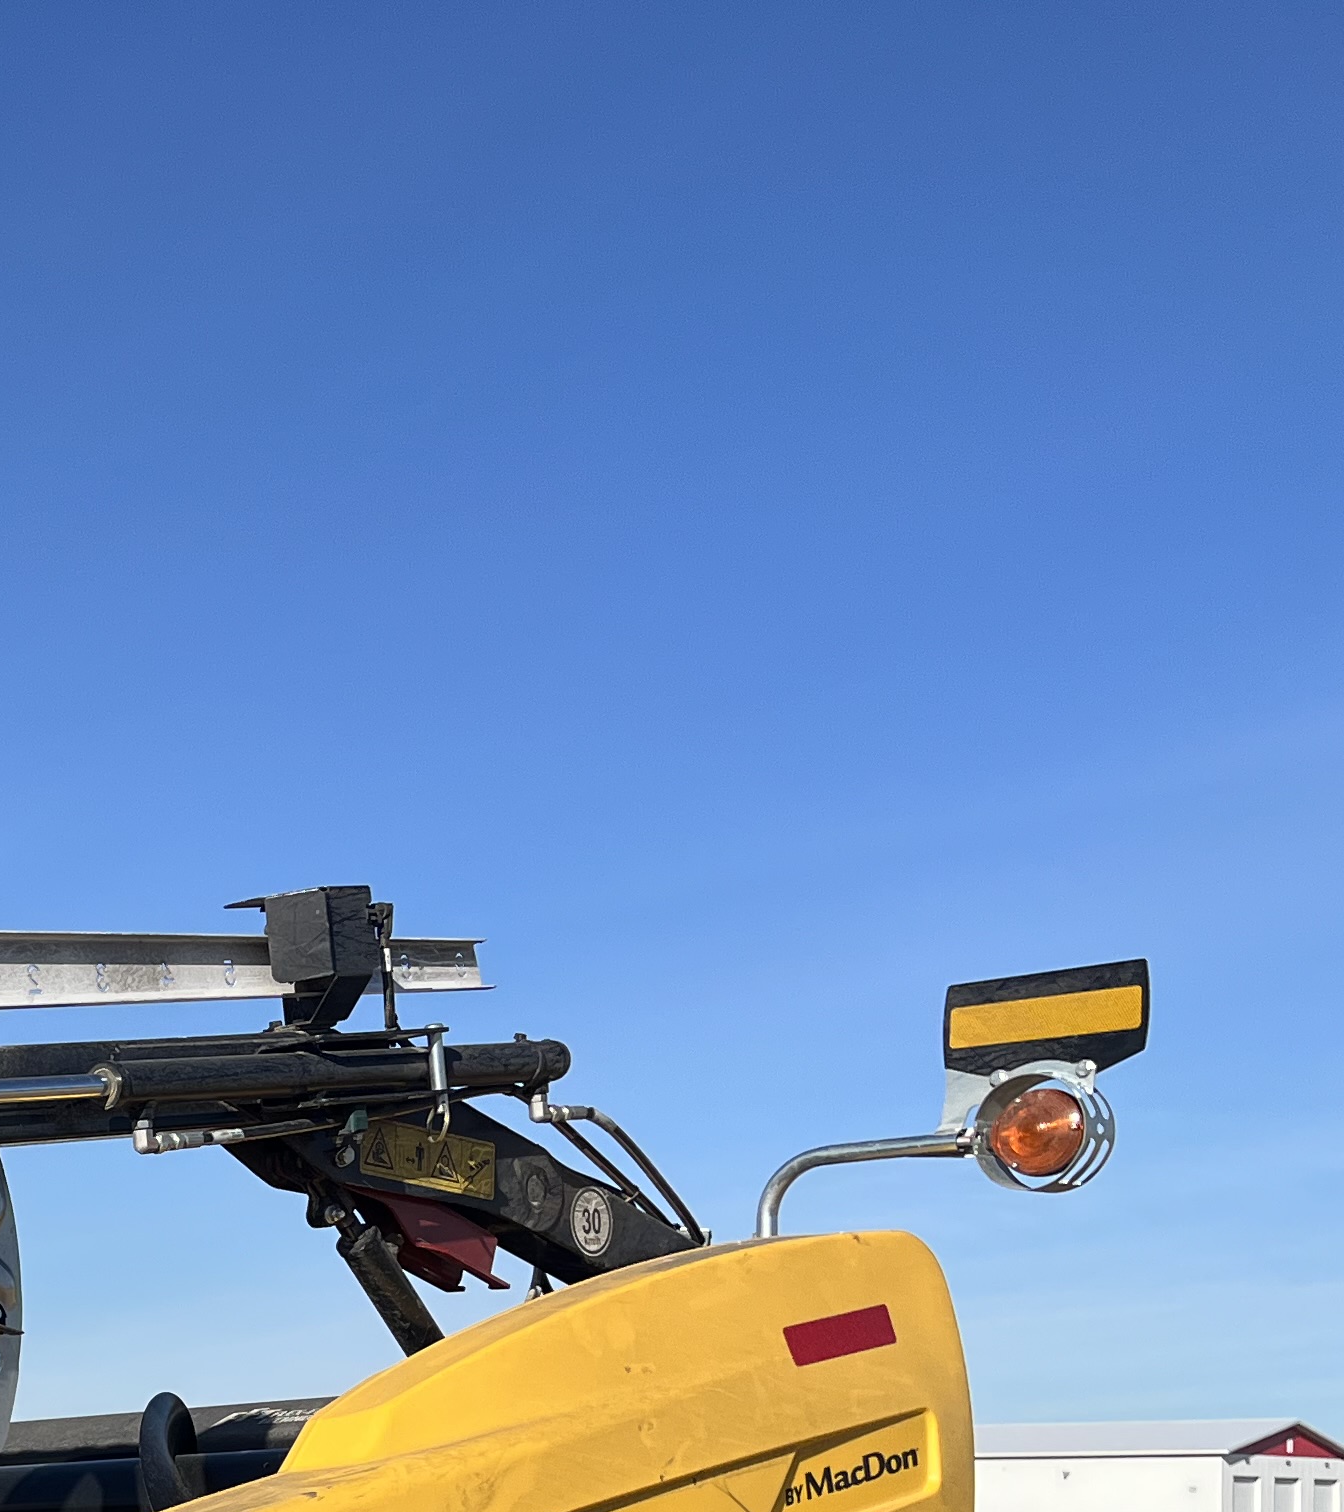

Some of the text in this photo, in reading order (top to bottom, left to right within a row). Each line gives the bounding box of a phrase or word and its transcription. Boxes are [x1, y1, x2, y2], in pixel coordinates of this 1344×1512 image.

[582, 1208, 601, 1235] 30
[785, 1448, 919, 1506] BY MacDon
